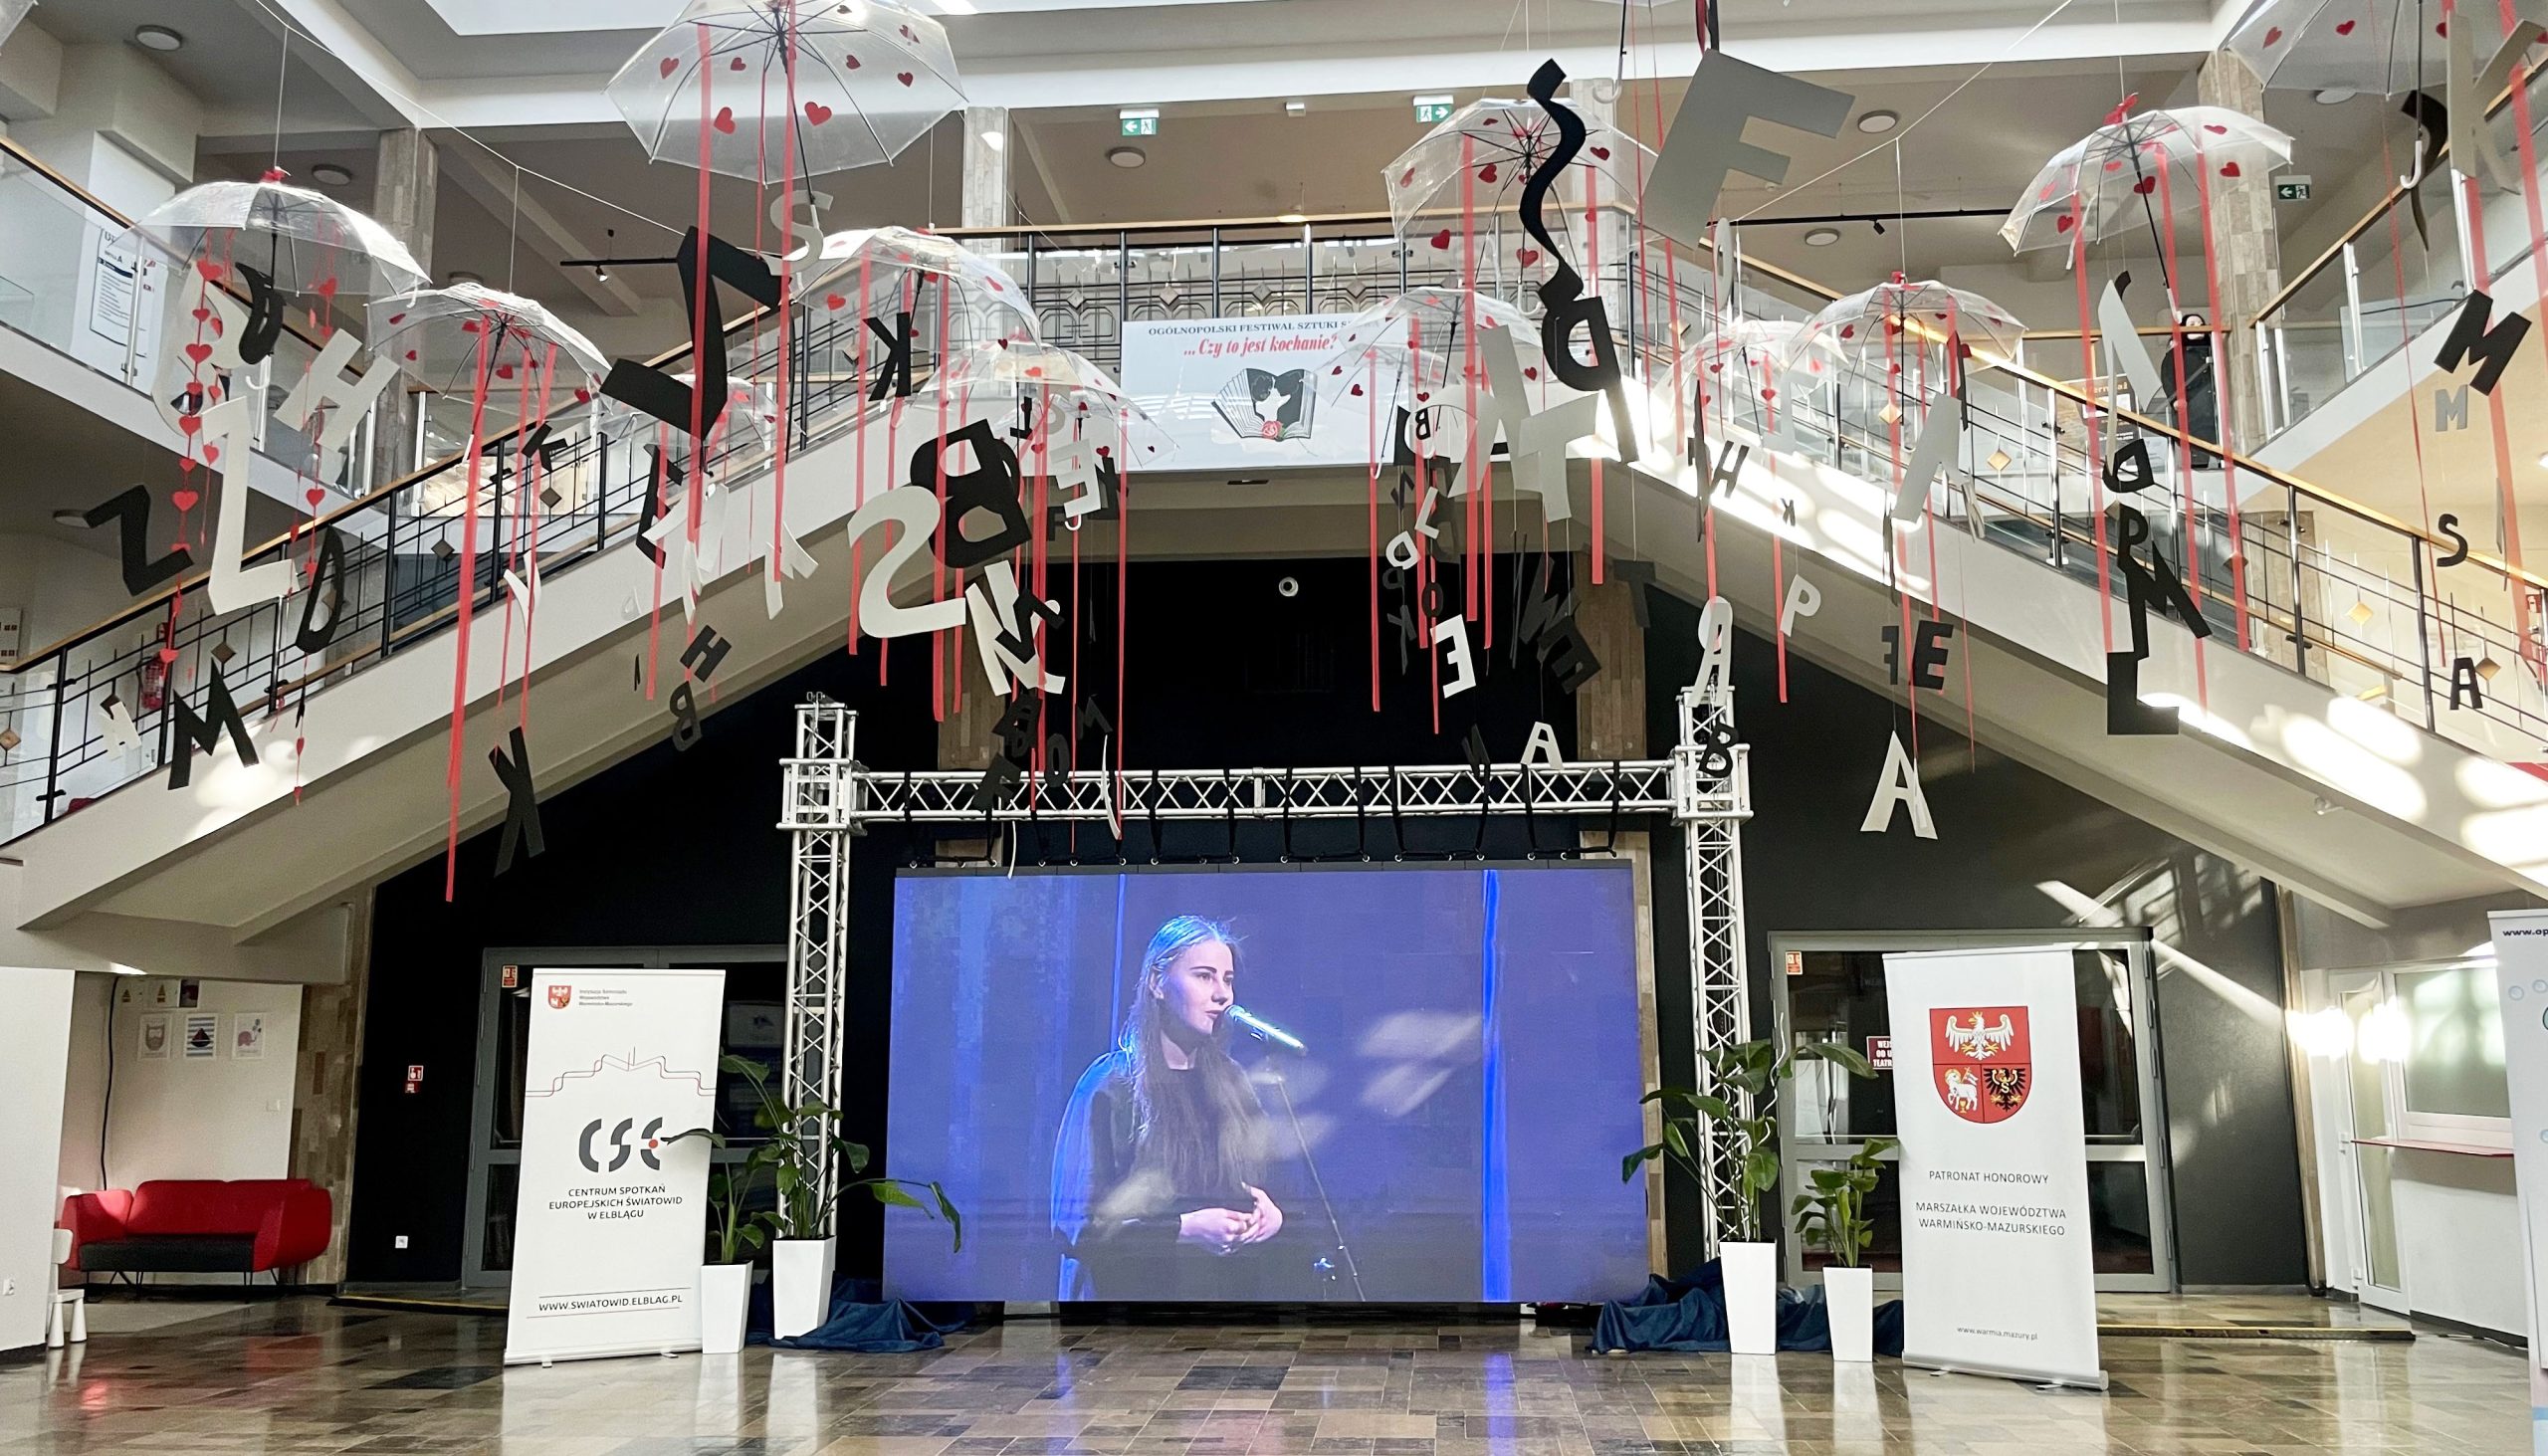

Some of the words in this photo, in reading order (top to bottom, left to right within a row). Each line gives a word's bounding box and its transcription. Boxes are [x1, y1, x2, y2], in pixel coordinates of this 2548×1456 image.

[1633, 49, 1856, 251] F
[1148, 324, 1237, 335] OGÓLNOPOLSKI
[1239, 322, 1295, 332] FESTIWAL
[1297, 321, 1339, 330] SZTUKI
[1226, 339, 1241, 353] to
[1241, 336, 1266, 359] jest
[1270, 334, 1339, 352] kochanie?
[2434, 289, 2532, 396] M
[273, 327, 400, 448] H
[2435, 384, 2468, 432] M
[85, 484, 194, 595] Z
[2437, 513, 2468, 567] S
[1780, 573, 1821, 637] P
[680, 624, 732, 683] H
[1910, 619, 1954, 691] E
[2107, 651, 2180, 735] L
[2449, 656, 2483, 711] A
[167, 657, 260, 790] M
[1520, 721, 1565, 770] A
[1698, 721, 1739, 778] B
[1860, 729, 1939, 840] A
[548, 1198, 623, 1210] EUROPEJSKICH
[625, 1195, 683, 1207] ŚWIATOWID
[568, 1186, 617, 1197] CENTRUM
[619, 1183, 666, 1195] SPOTKAŃ
[1929, 1170, 1980, 1181] PATRONAT
[1983, 1172, 2049, 1184] HONOROWY
[587, 1211, 597, 1220] W
[599, 1209, 644, 1220] ELBLĄGU
[1915, 1201, 1977, 1214] MARSZAŁKA
[1979, 1204, 2066, 1219] WOJEWÓDZTWA
[1918, 1218, 2065, 1236] WARMIŃSKO-MAZURSKIEGO
[538, 1295, 683, 1312] WWW.SWIATOWID.ELBLAG.PL
